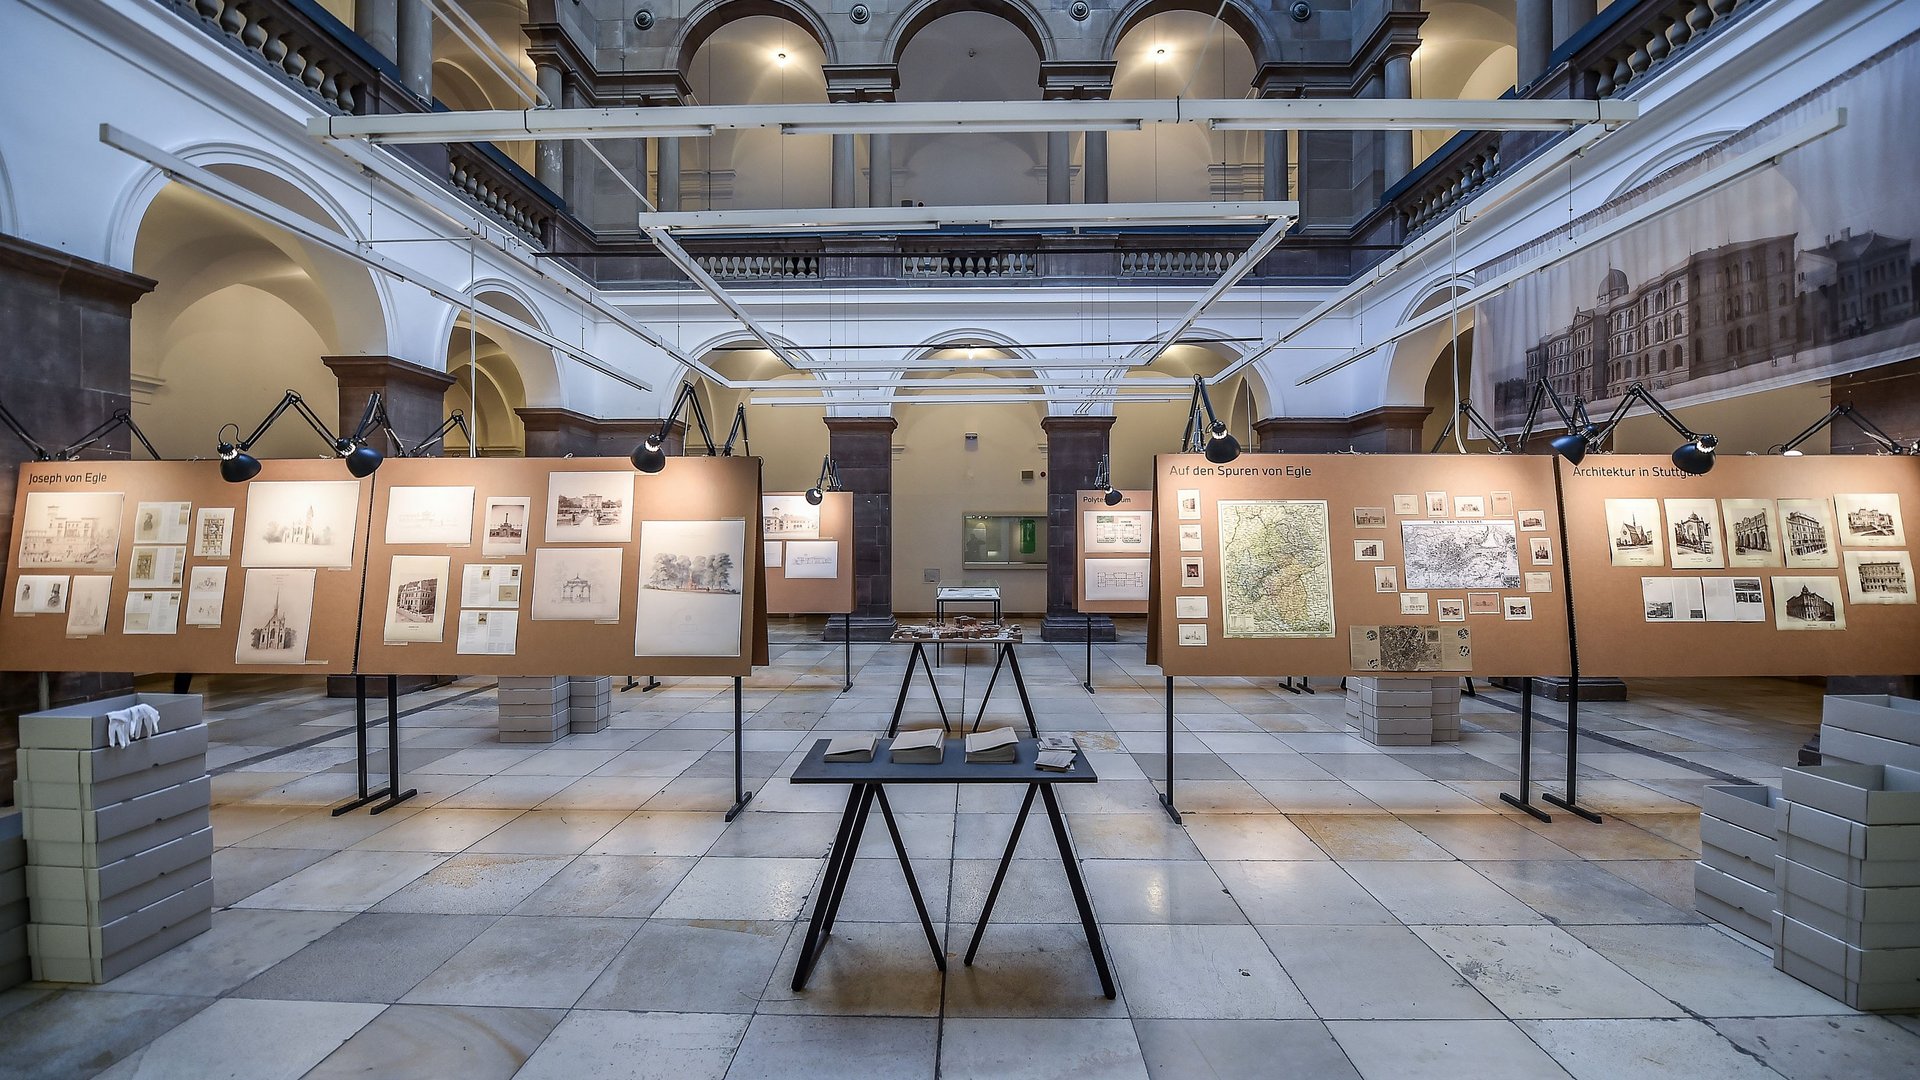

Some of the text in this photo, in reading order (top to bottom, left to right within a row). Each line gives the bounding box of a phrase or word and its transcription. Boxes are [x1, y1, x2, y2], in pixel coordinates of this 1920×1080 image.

[1169, 465, 1312, 479] Auf den Spuren von Egle
[1573, 466, 1636, 477] Architektur
[1638, 466, 1650, 477] in
[28, 472, 107, 486] Joseph von Egle
